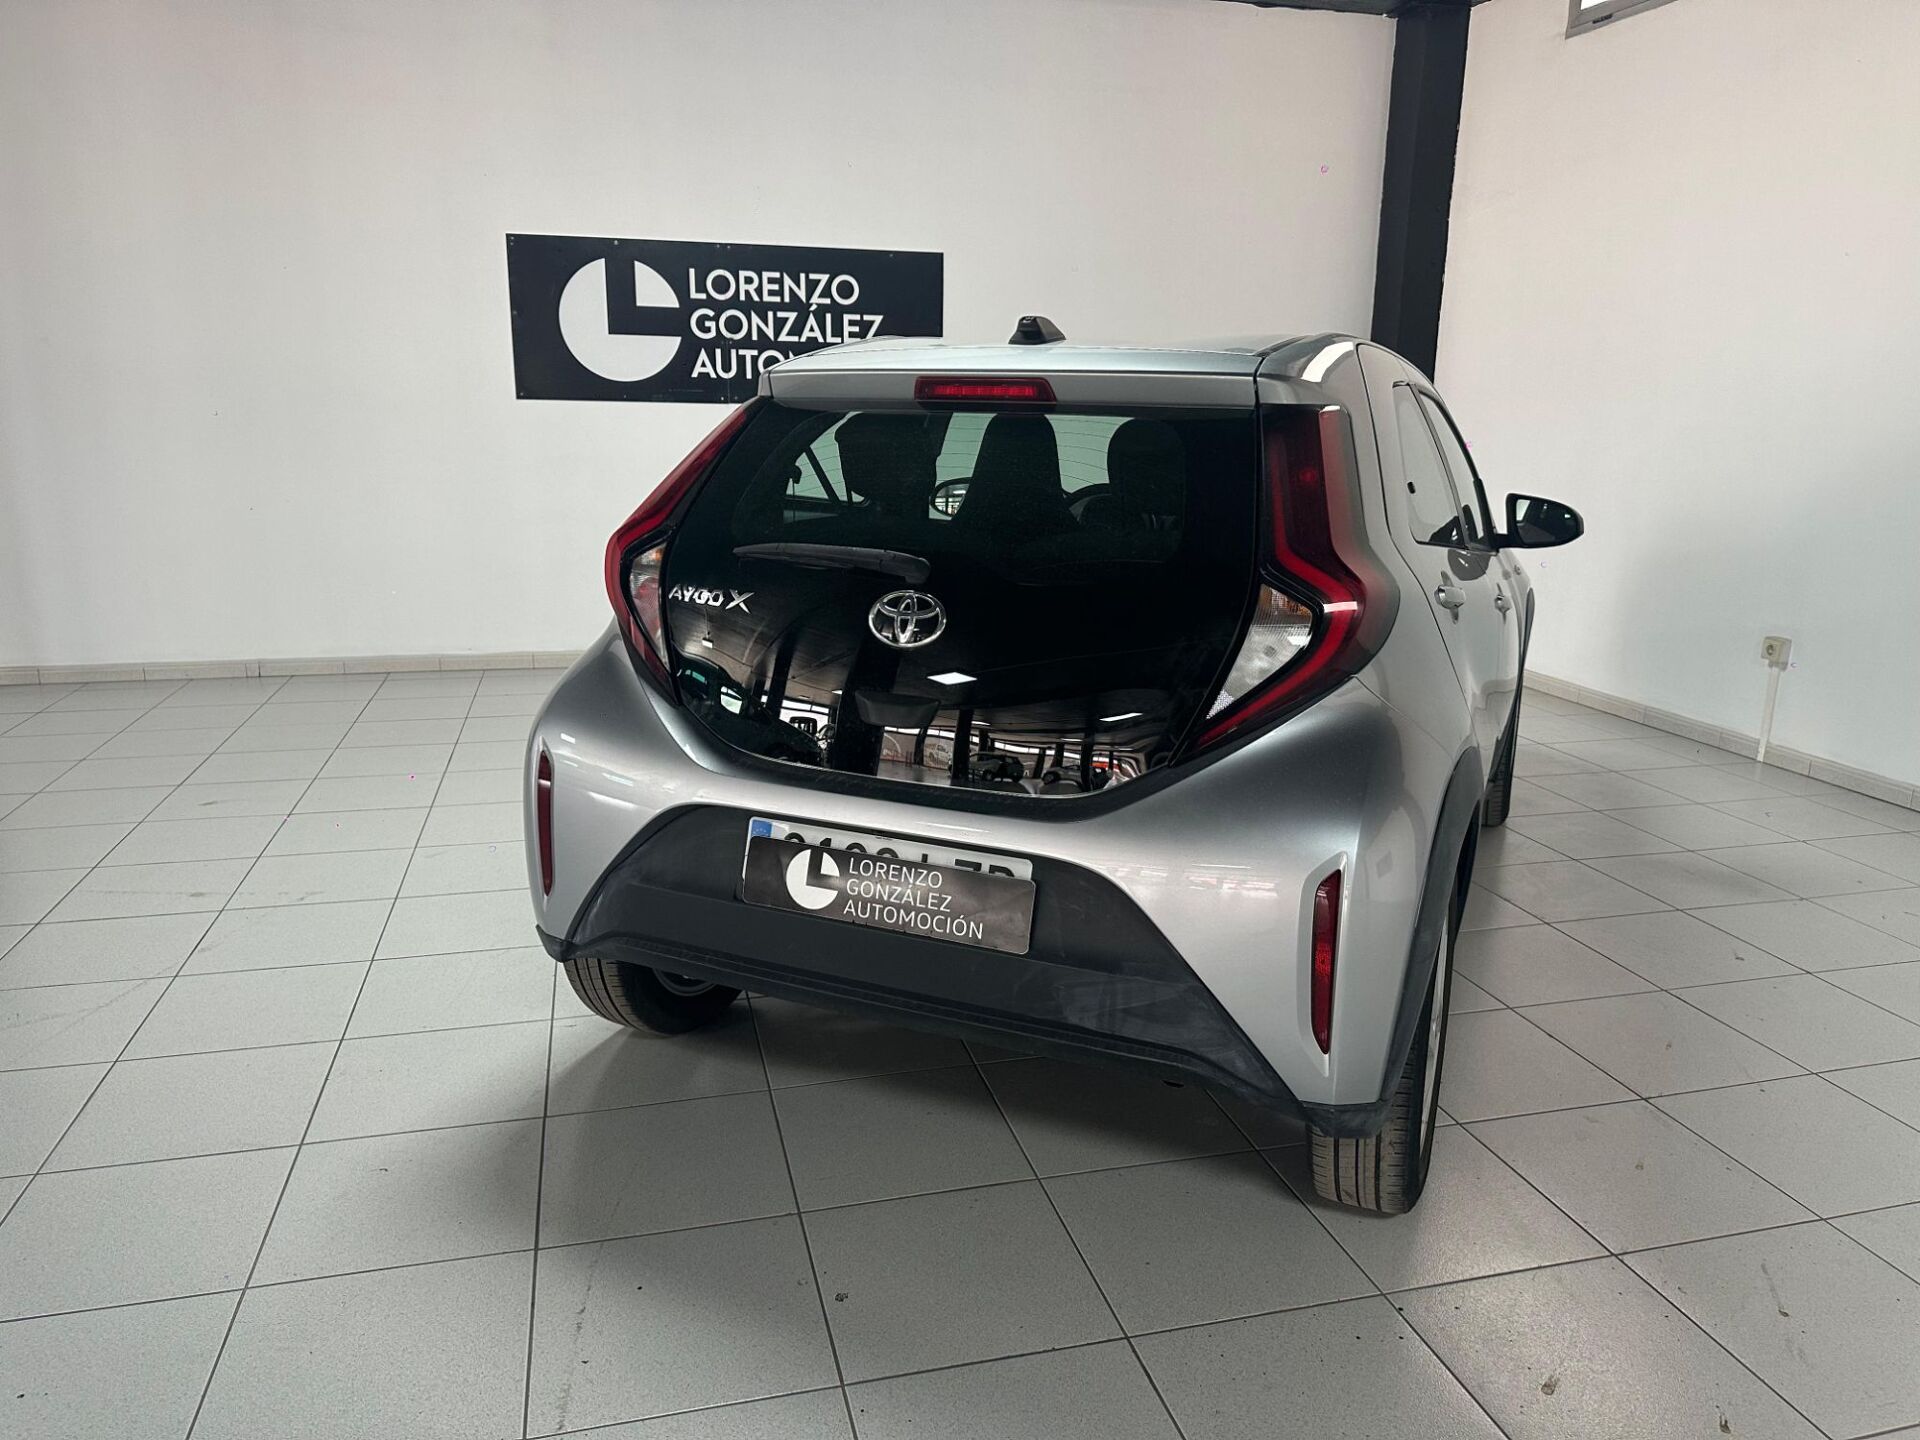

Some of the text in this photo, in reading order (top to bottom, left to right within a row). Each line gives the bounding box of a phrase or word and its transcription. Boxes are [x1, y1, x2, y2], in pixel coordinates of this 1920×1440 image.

[688, 267, 860, 306] LORENZO
[689, 304, 884, 343] GONZÁLEZ
[725, 589, 755, 614] X
[848, 857, 943, 889] LORENZO
[846, 880, 952, 913] GONZÁLEZ
[843, 899, 983, 939] AUTOMOCIÓN
